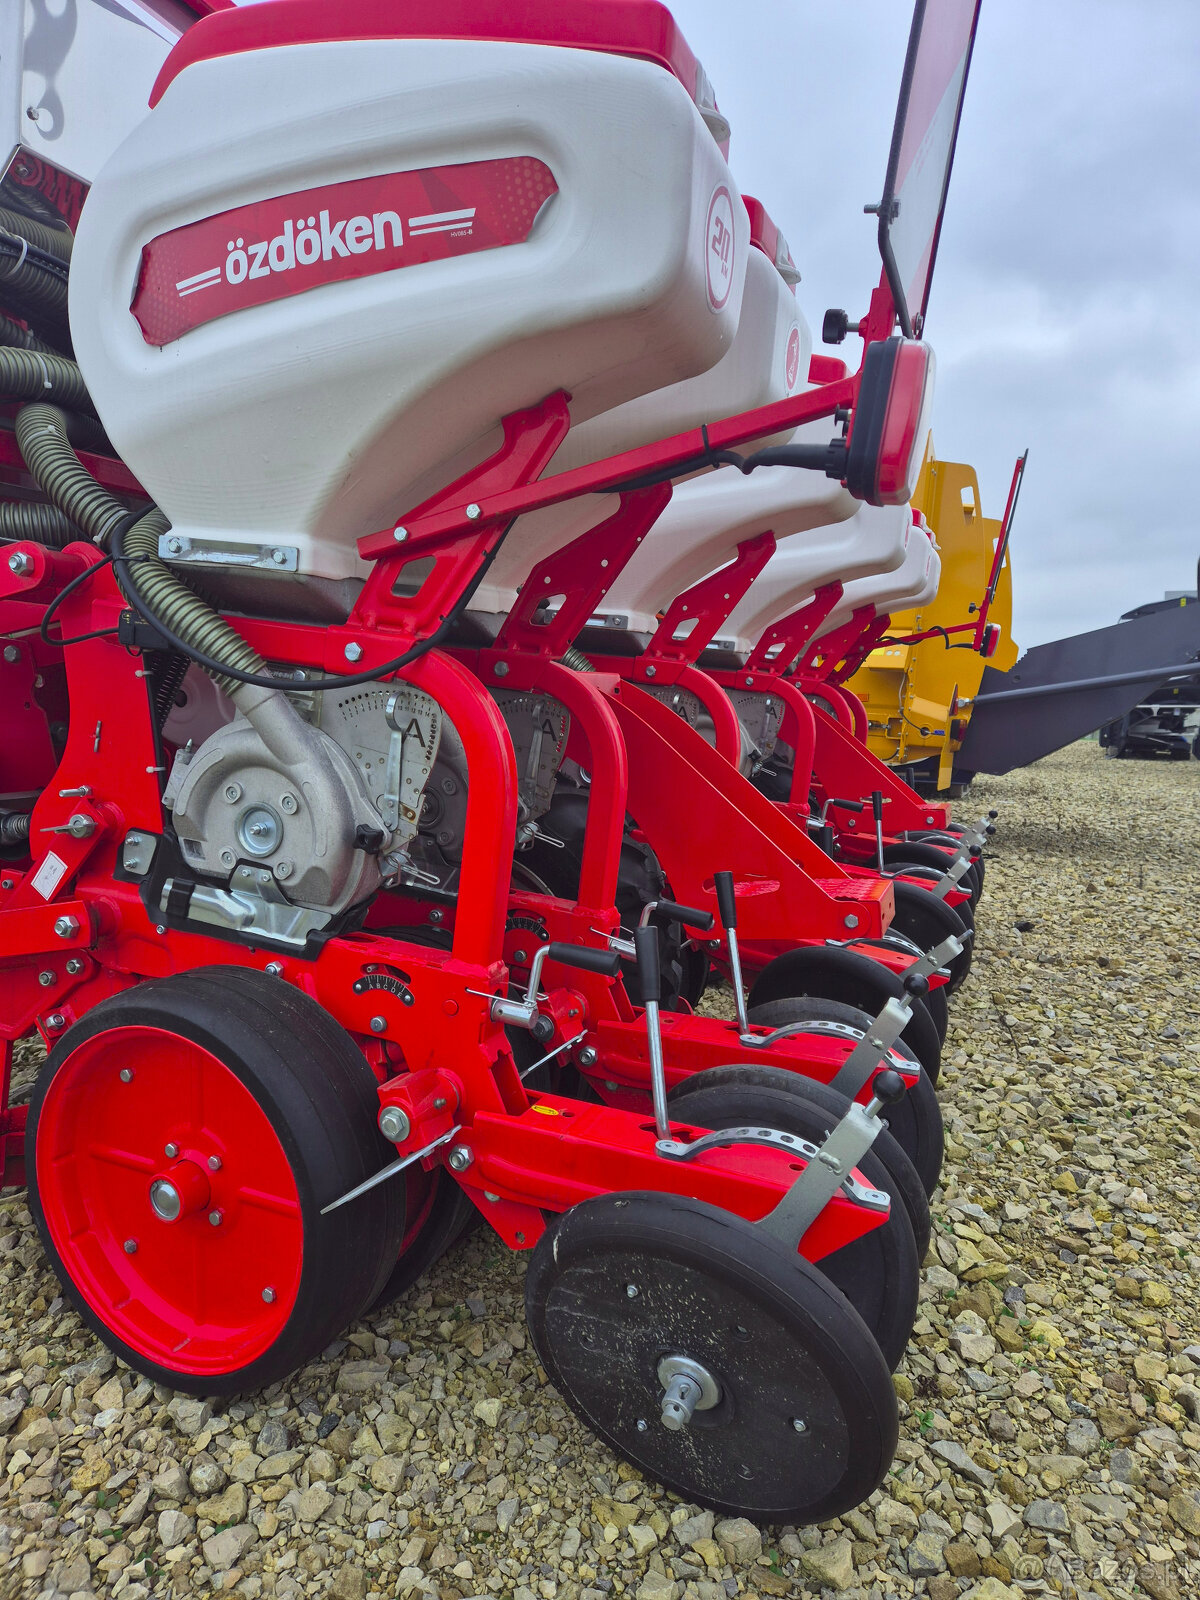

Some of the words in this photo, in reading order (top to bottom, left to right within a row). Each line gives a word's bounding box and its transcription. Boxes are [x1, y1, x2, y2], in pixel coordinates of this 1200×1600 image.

[225, 209, 404, 285] özdöken
[402, 718, 426, 748] A
[542, 719, 557, 741] A
